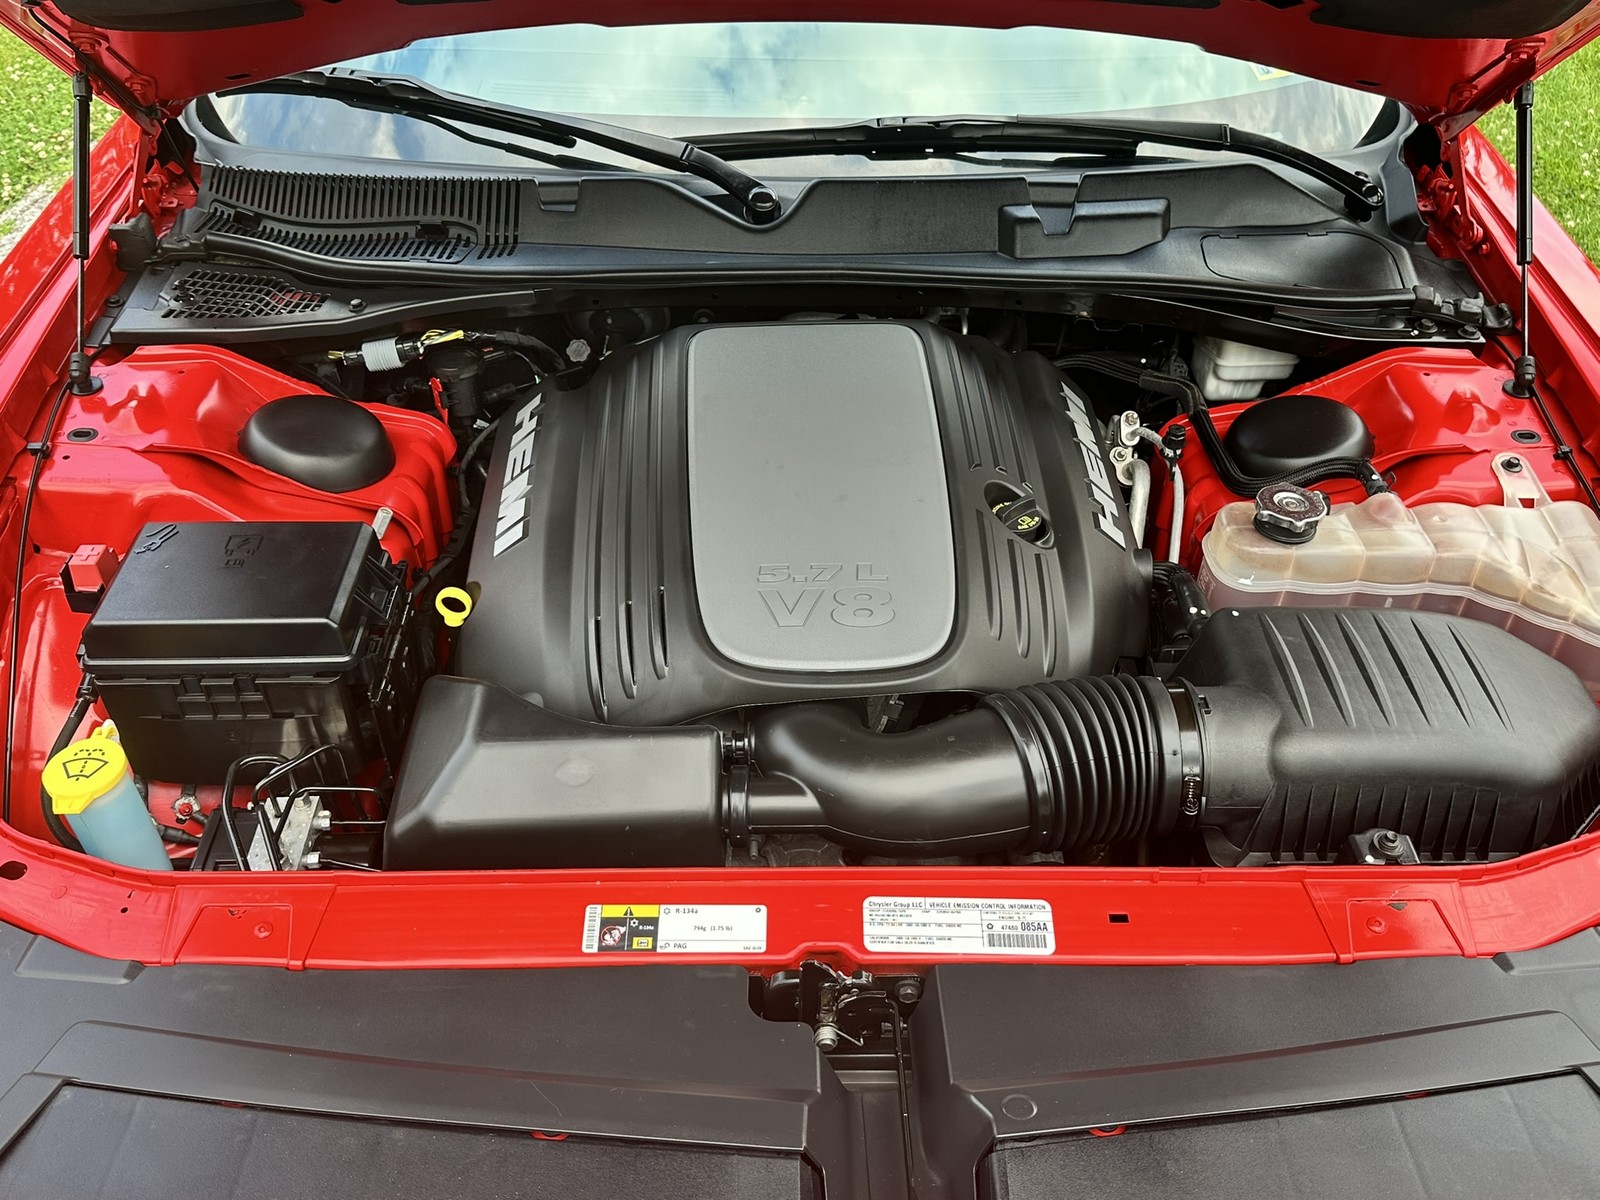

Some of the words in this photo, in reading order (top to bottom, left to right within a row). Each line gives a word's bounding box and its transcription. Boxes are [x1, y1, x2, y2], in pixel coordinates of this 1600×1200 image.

[493, 393, 543, 558] HEMI
[1060, 381, 1127, 550] HEMI
[757, 563, 843, 583] 5.7
[856, 562, 889, 582] L
[757, 585, 896, 628] V8
[868, 900, 892, 909] Chrysler
[893, 901, 910, 909] Group
[1020, 921, 1048, 932] 085AA
[673, 942, 688, 950] PAG
